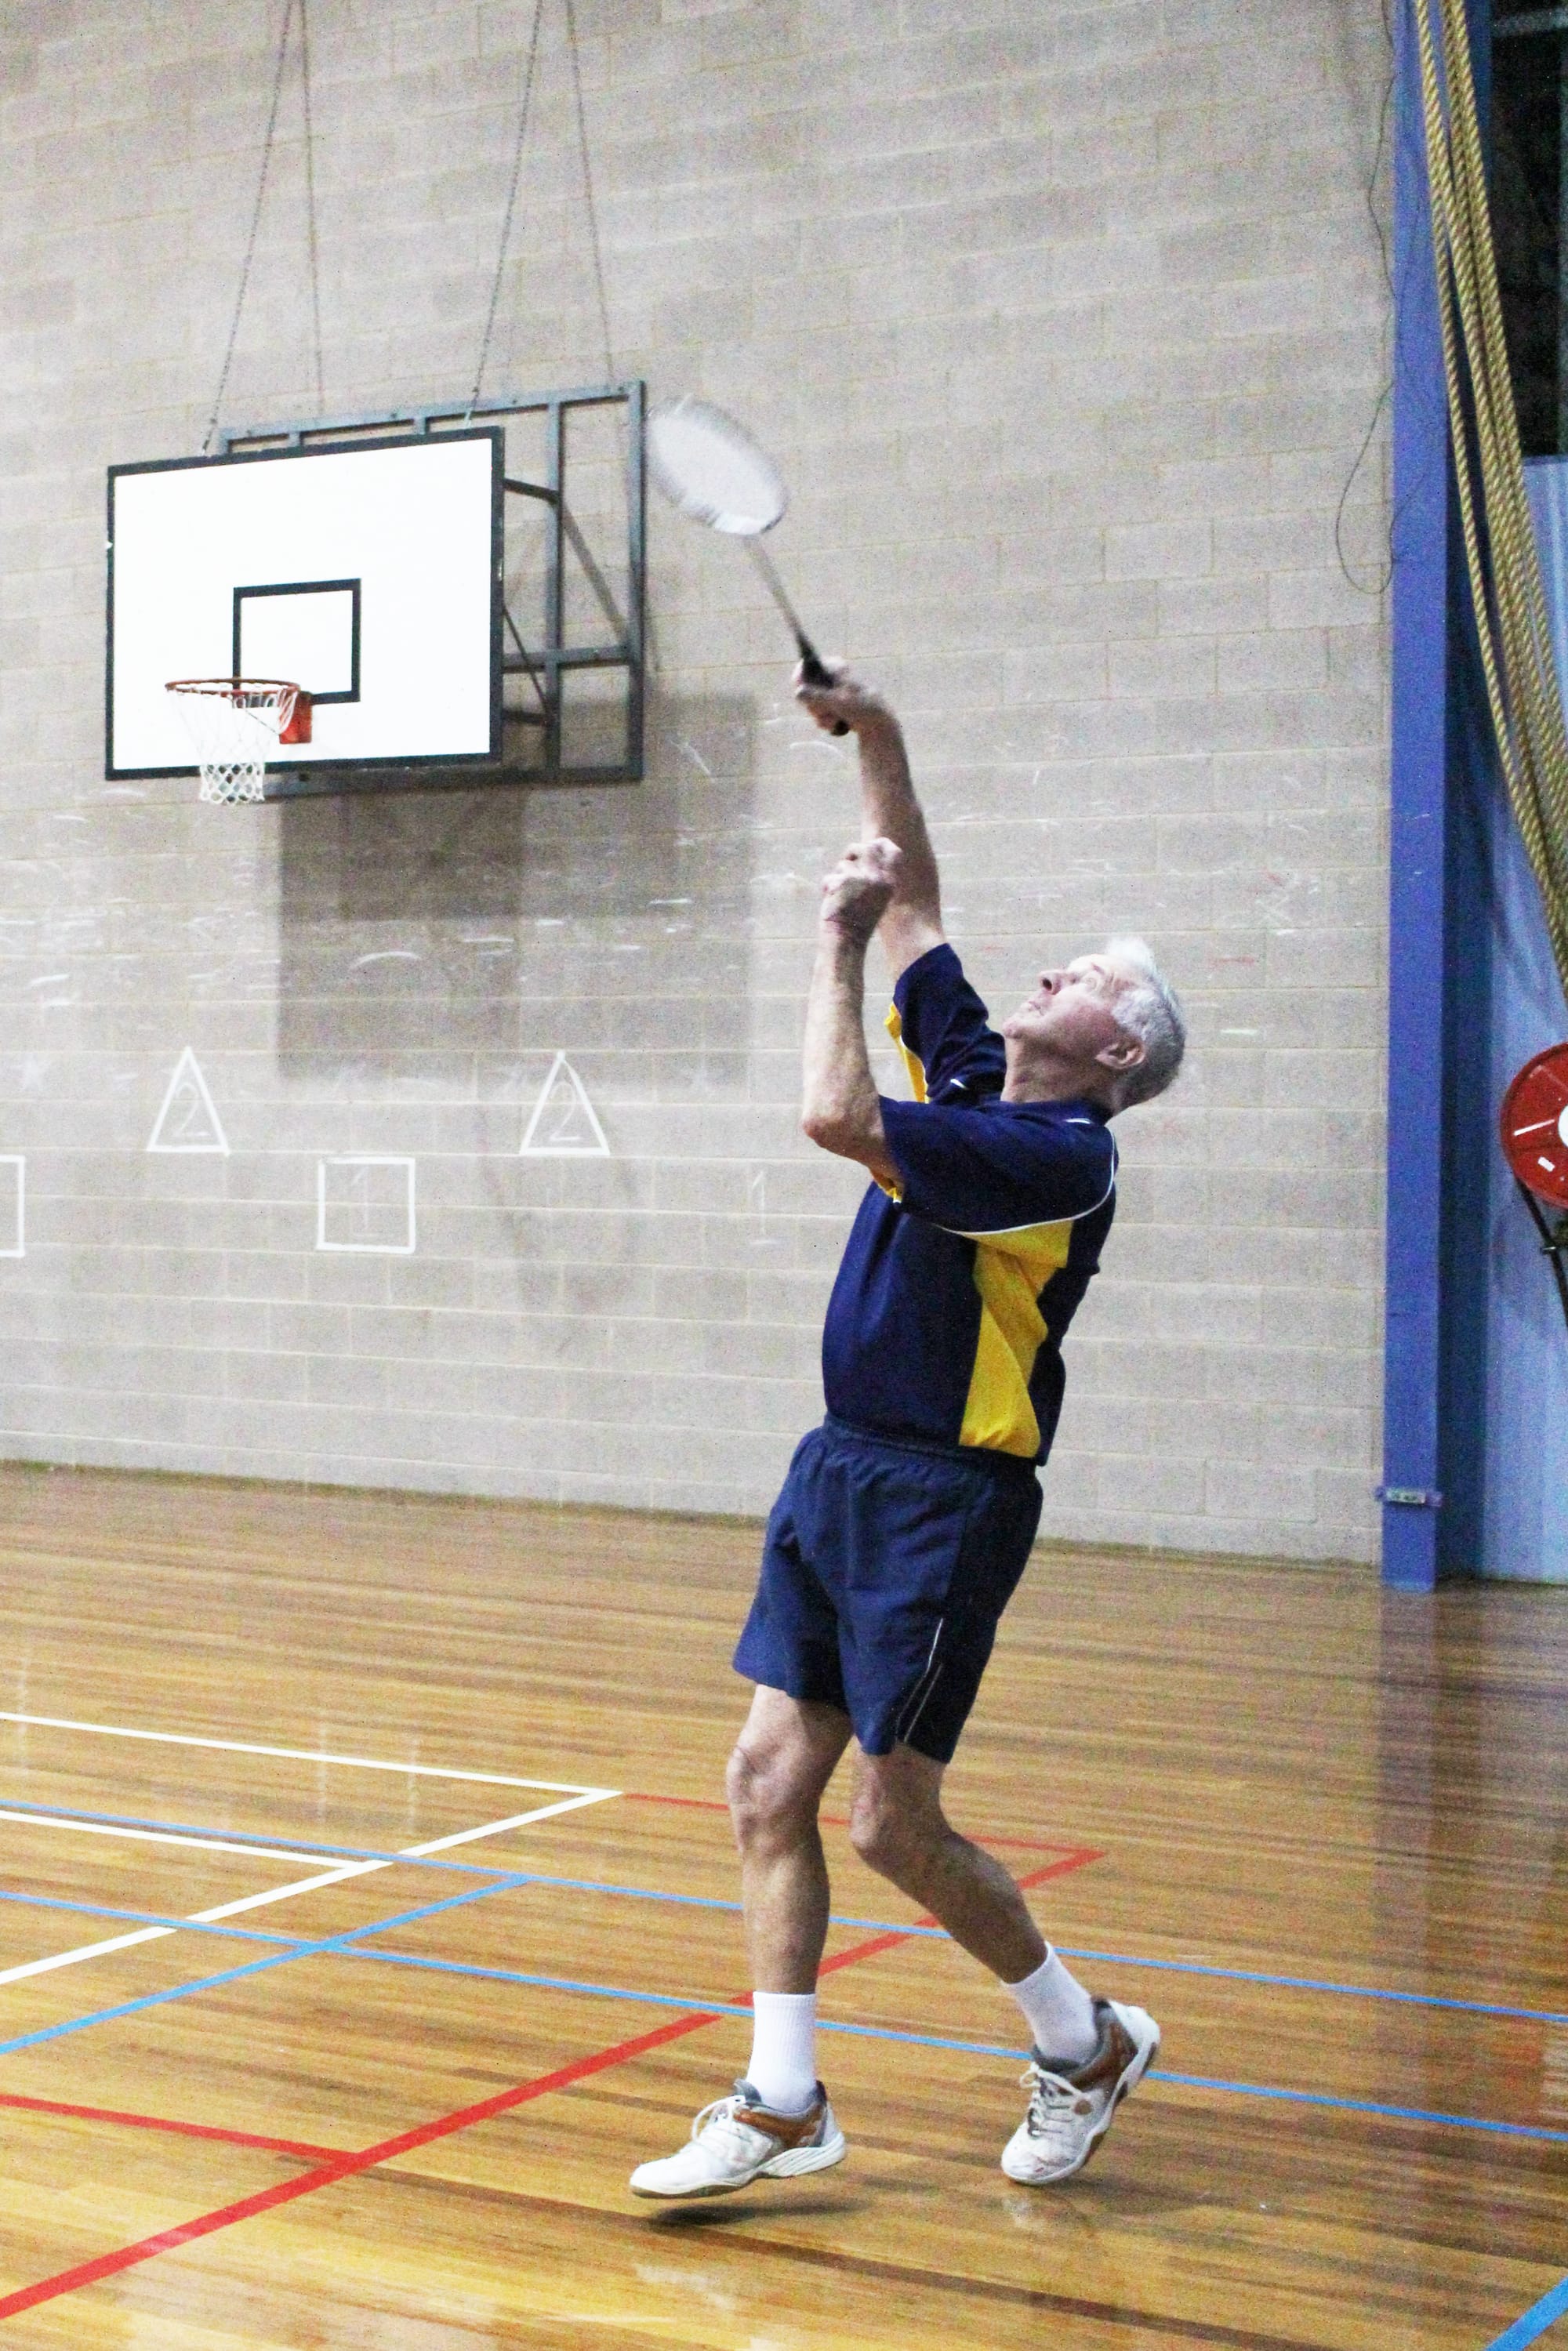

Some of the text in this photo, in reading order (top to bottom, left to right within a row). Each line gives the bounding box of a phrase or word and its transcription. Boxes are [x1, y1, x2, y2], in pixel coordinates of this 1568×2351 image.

[173, 1081, 211, 1137] 2
[549, 1080, 583, 1141] 2
[350, 1165, 381, 1239] 1
